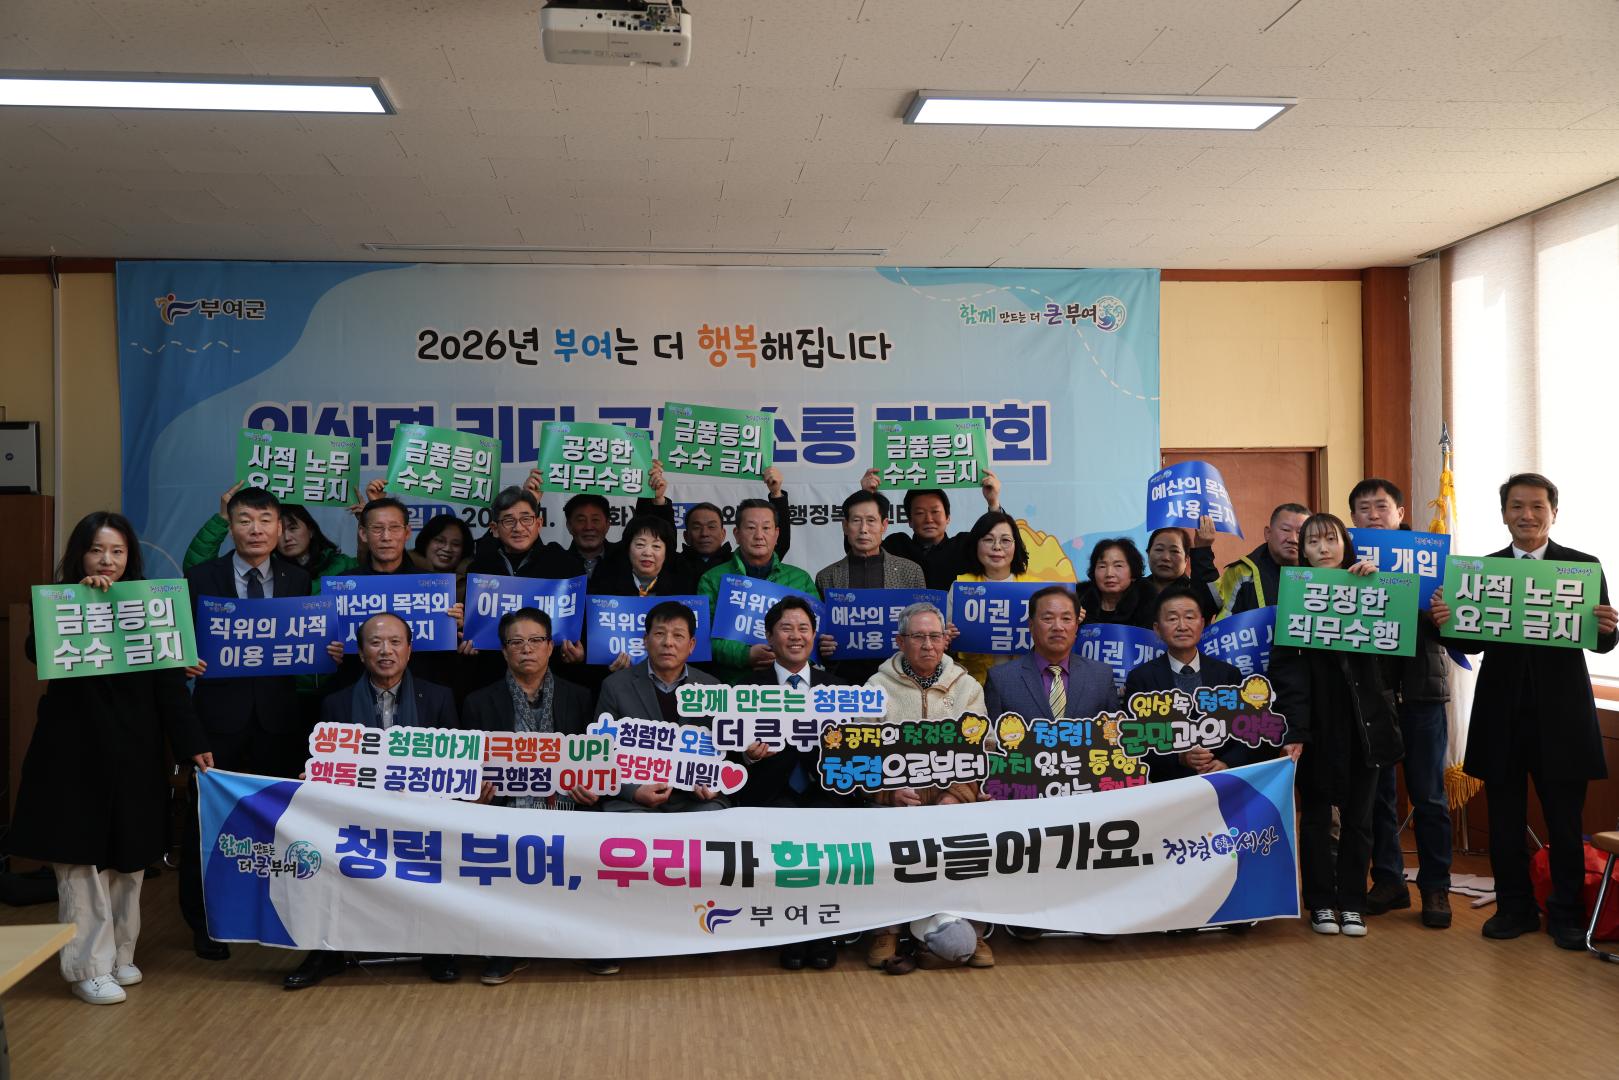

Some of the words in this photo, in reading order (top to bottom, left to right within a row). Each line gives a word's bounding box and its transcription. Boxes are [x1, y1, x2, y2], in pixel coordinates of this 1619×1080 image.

[199, 299, 266, 320] 부여군
[960, 303, 996, 324] 함께
[1000, 311, 1027, 324] 만드는
[1030, 311, 1041, 323] 더
[1044, 303, 1063, 325] 큰
[1065, 303, 1097, 325] 부여
[418, 327, 539, 366] 2026년
[553, 327, 639, 366] 부여는
[653, 331, 684, 360] 더
[697, 323, 892, 369] 행복해집니다
[674, 418, 761, 450] 금품등의
[886, 433, 974, 460] 금품등의
[248, 444, 298, 473] 사적
[304, 451, 351, 475] 노무
[404, 438, 493, 475] 금품등의
[562, 435, 635, 465] 공정한
[668, 445, 712, 470] 수수
[719, 449, 763, 475] 금지
[397, 465, 444, 494] 수수
[449, 474, 493, 503] 금지
[549, 463, 643, 494] 직무수행
[883, 462, 928, 485] 수수
[934, 459, 978, 485] 금지
[247, 472, 295, 499] 요구
[303, 475, 349, 503] 금지
[1151, 476, 1202, 501] 예산의
[1166, 500, 1201, 520] 사용
[1207, 501, 1237, 528] 금지
[1391, 547, 1438, 578] 개입
[392, 592, 450, 615] 목적외
[533, 592, 577, 618] 개입
[1303, 582, 1390, 617] 공정한
[1455, 573, 1513, 605] 사적
[1523, 577, 1585, 609] 노무
[55, 597, 176, 636] 금품등의
[831, 606, 884, 626] 예산의
[964, 598, 1010, 624] 이권
[1454, 605, 1512, 637] 요구
[1522, 610, 1581, 643] 금지
[209, 616, 277, 641] 직위의
[284, 615, 328, 639] 사적
[846, 631, 884, 651] 사용
[1203, 627, 1259, 657] 직위의
[1288, 614, 1401, 652] 직무수행
[53, 637, 113, 671] 수수
[123, 630, 184, 665] 금지
[219, 644, 265, 668] 이용
[272, 643, 316, 666] 금지
[1081, 640, 1124, 666] 이권
[680, 688, 728, 713] 함께
[736, 688, 806, 713] 만드는
[813, 688, 885, 713] 청렴한
[314, 726, 381, 756] 생각은
[388, 730, 481, 761] 청렴하게
[619, 722, 677, 752] 청렴한
[716, 718, 744, 748] 더
[845, 726, 900, 749] 공직의
[1033, 721, 1092, 748] 청렴!
[1122, 717, 1227, 754] 군민과의
[1231, 711, 1285, 745] 약속
[484, 736, 562, 763] 극행정
[568, 738, 610, 762] UP!
[989, 752, 1032, 776] 가치
[1034, 750, 1082, 777] 있는
[310, 761, 377, 790] 행동은
[384, 765, 478, 795] 공정하게
[482, 765, 552, 792] 극행정
[559, 768, 617, 792] OUT!
[616, 753, 673, 783] 당당한
[675, 760, 721, 788] 내일!
[822, 750, 986, 790] 청렴으로부터
[220, 834, 252, 856] 함께
[253, 843, 276, 856] 만드는
[335, 824, 443, 884] 청렴
[459, 832, 582, 891] 부여,
[597, 837, 760, 889] 우리가
[770, 840, 876, 889] 함께
[888, 818, 1154, 884] 만들어가요.
[239, 859, 252, 872] 더
[254, 855, 269, 877] 큰
[270, 859, 297, 878] 부여
[750, 903, 842, 927] 부여군
